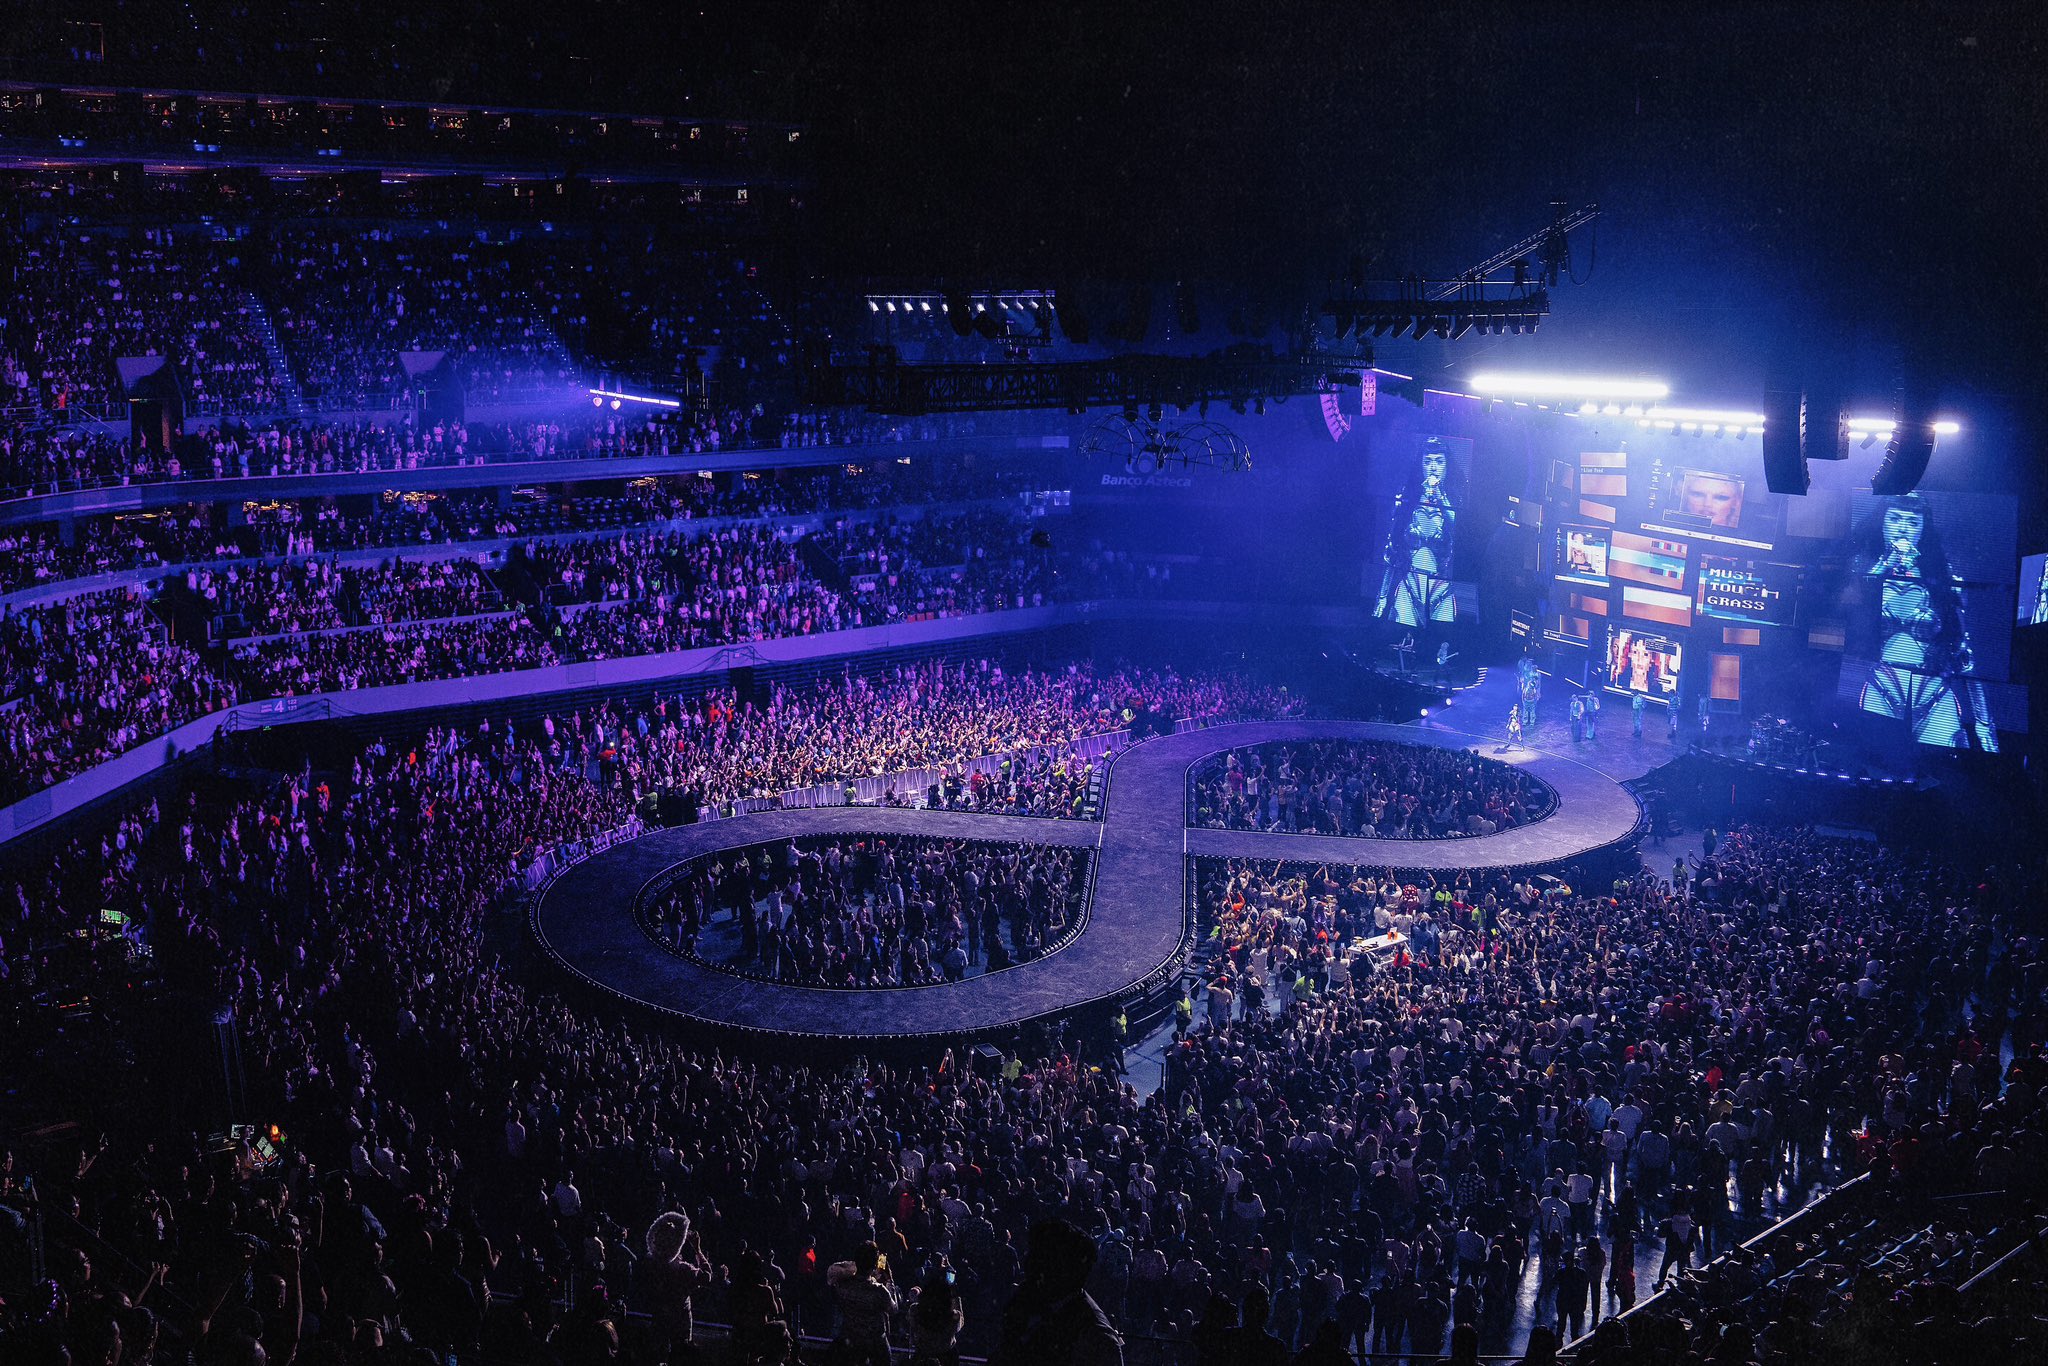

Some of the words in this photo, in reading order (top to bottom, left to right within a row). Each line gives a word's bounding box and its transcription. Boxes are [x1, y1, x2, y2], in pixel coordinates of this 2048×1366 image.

[1100, 474, 1142, 486] Banco
[1144, 475, 1192, 487] Azteca
[1707, 595, 1765, 611] GRASS
[274, 700, 284, 713] 4
